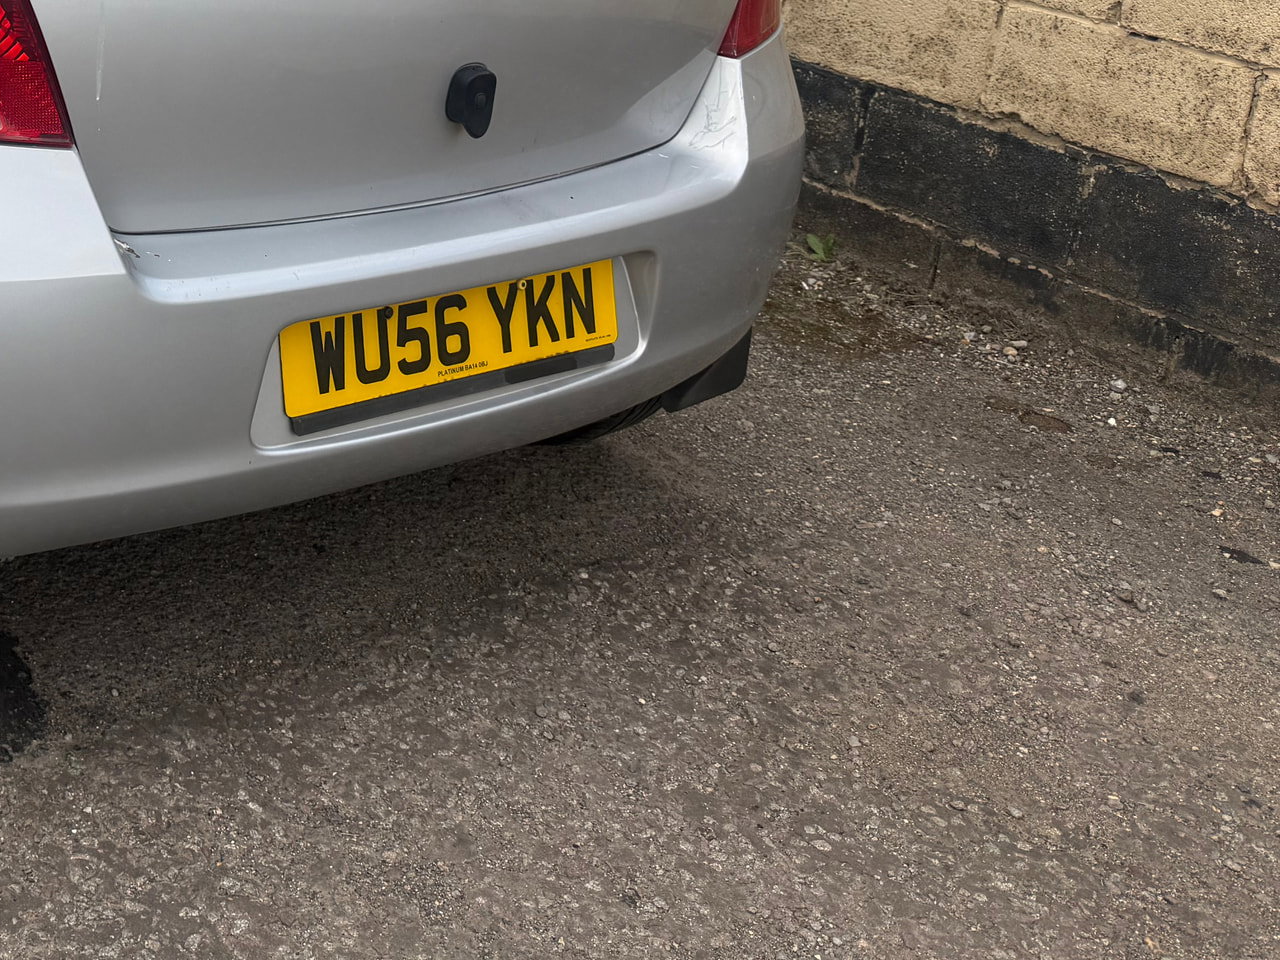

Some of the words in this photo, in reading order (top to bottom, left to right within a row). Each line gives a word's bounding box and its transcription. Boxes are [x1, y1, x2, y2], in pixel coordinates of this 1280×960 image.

[309, 293, 471, 395] WU56
[487, 267, 597, 354] YKN
[437, 365, 464, 377] PLATINUM
